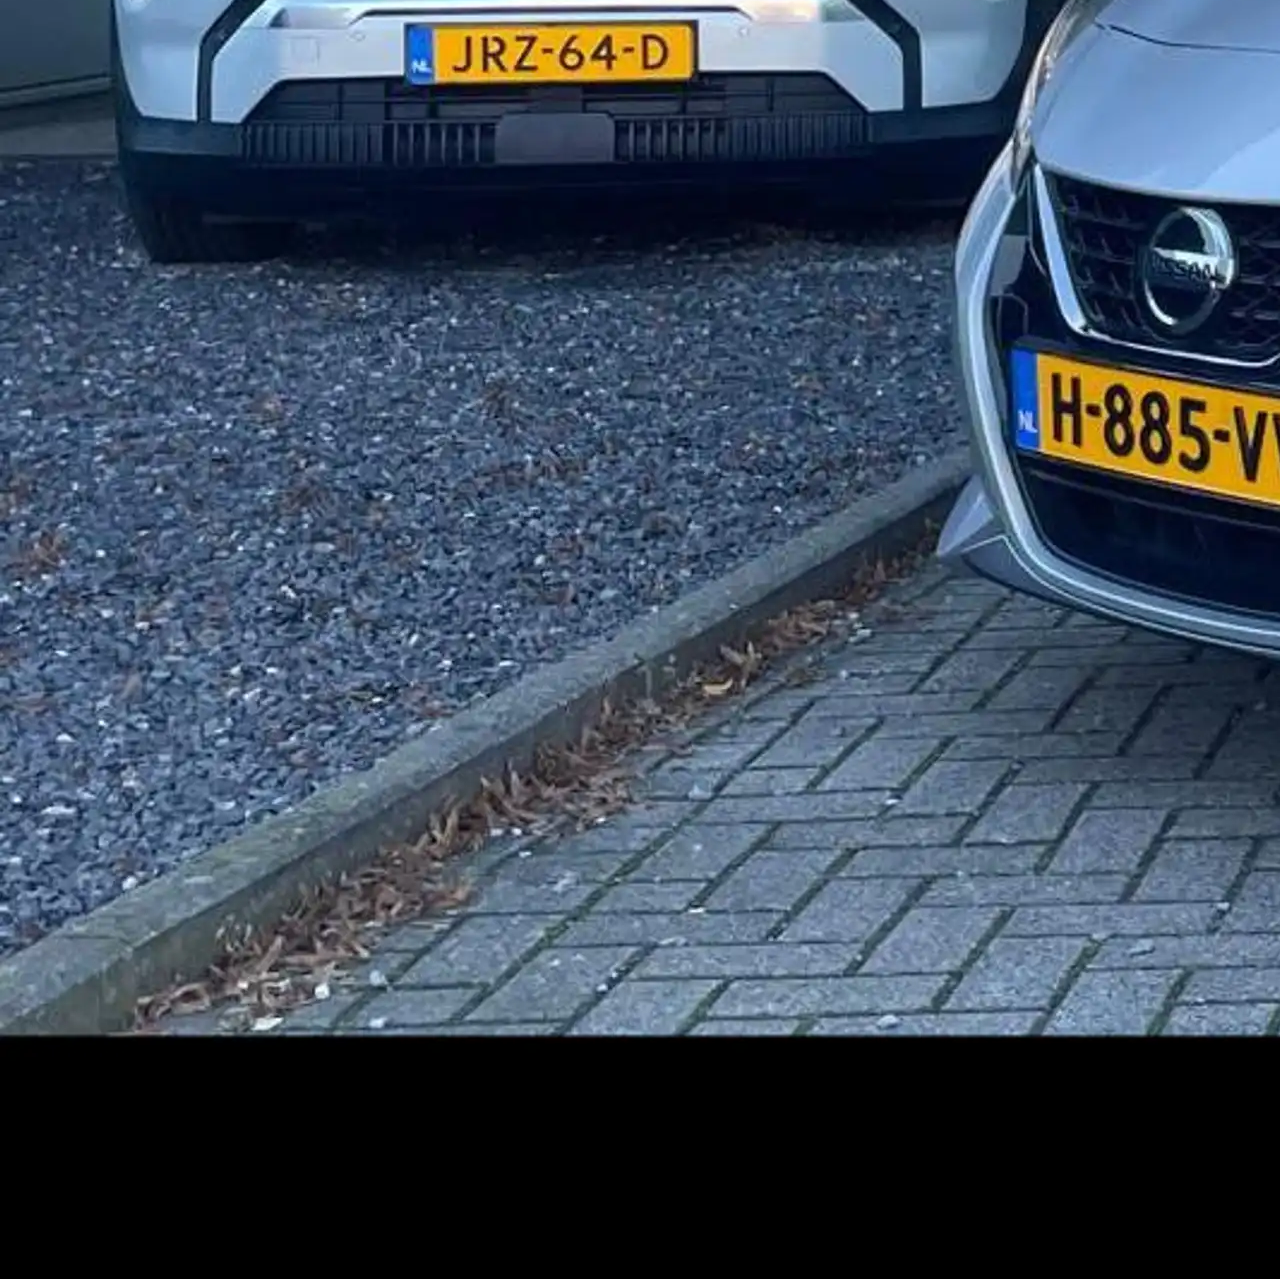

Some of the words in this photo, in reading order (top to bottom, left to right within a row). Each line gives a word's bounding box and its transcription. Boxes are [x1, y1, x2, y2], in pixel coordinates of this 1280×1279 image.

[452, 34, 669, 73] JRZ-64-D
[411, 59, 432, 72] NL
[1018, 411, 1037, 433] NL
